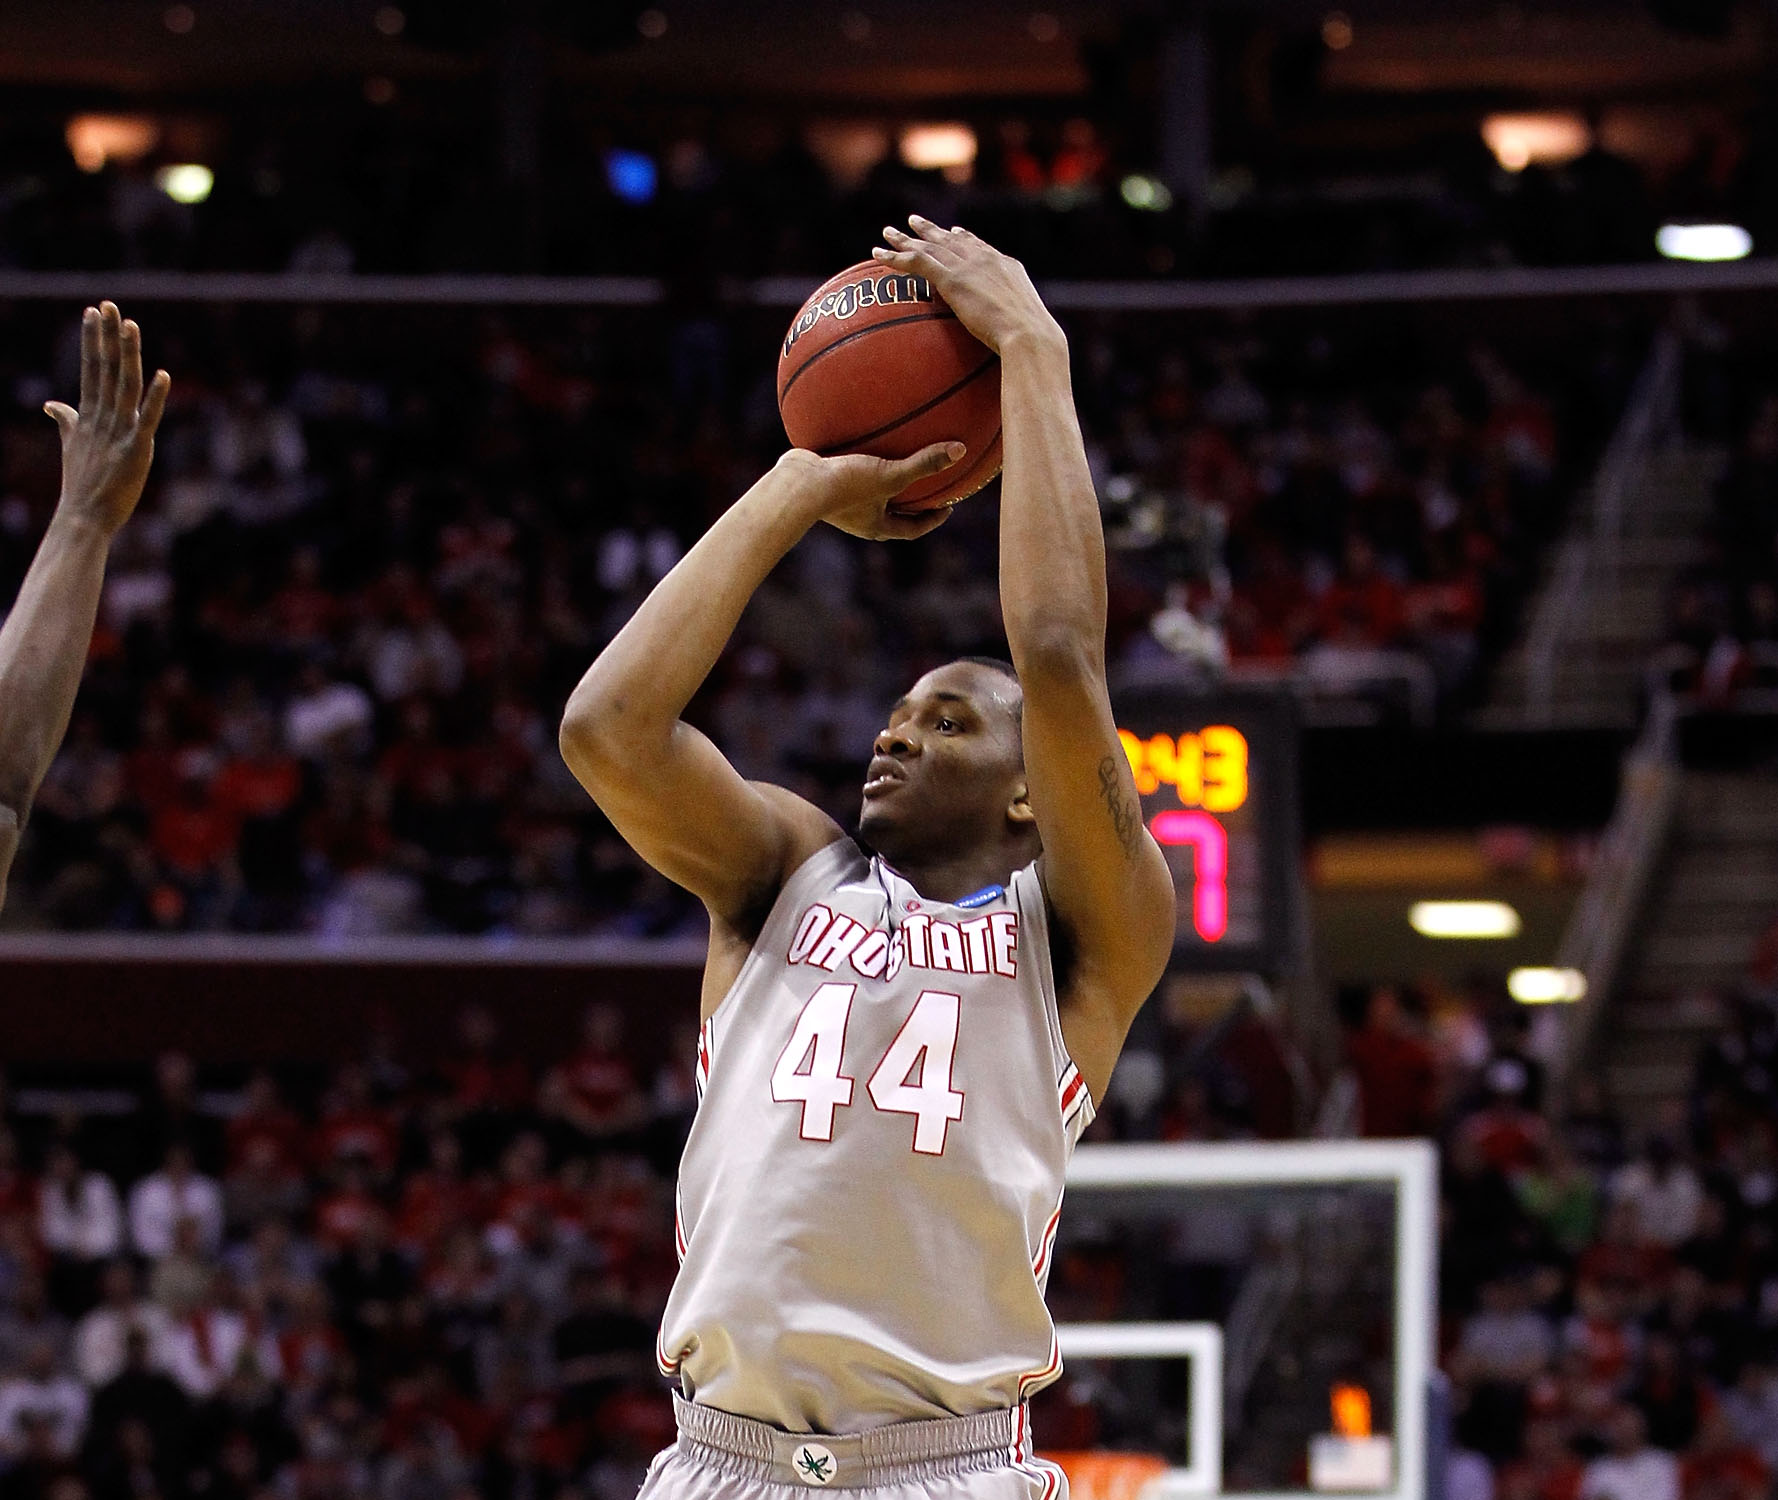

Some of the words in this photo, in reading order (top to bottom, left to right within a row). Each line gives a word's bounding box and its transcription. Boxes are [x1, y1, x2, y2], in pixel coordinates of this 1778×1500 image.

[783, 273, 933, 358] Wilson
[1150, 809, 1228, 943] 7
[787, 903, 890, 978] OHO
[885, 911, 1019, 983] STATE
[770, 982, 965, 1157] 44
